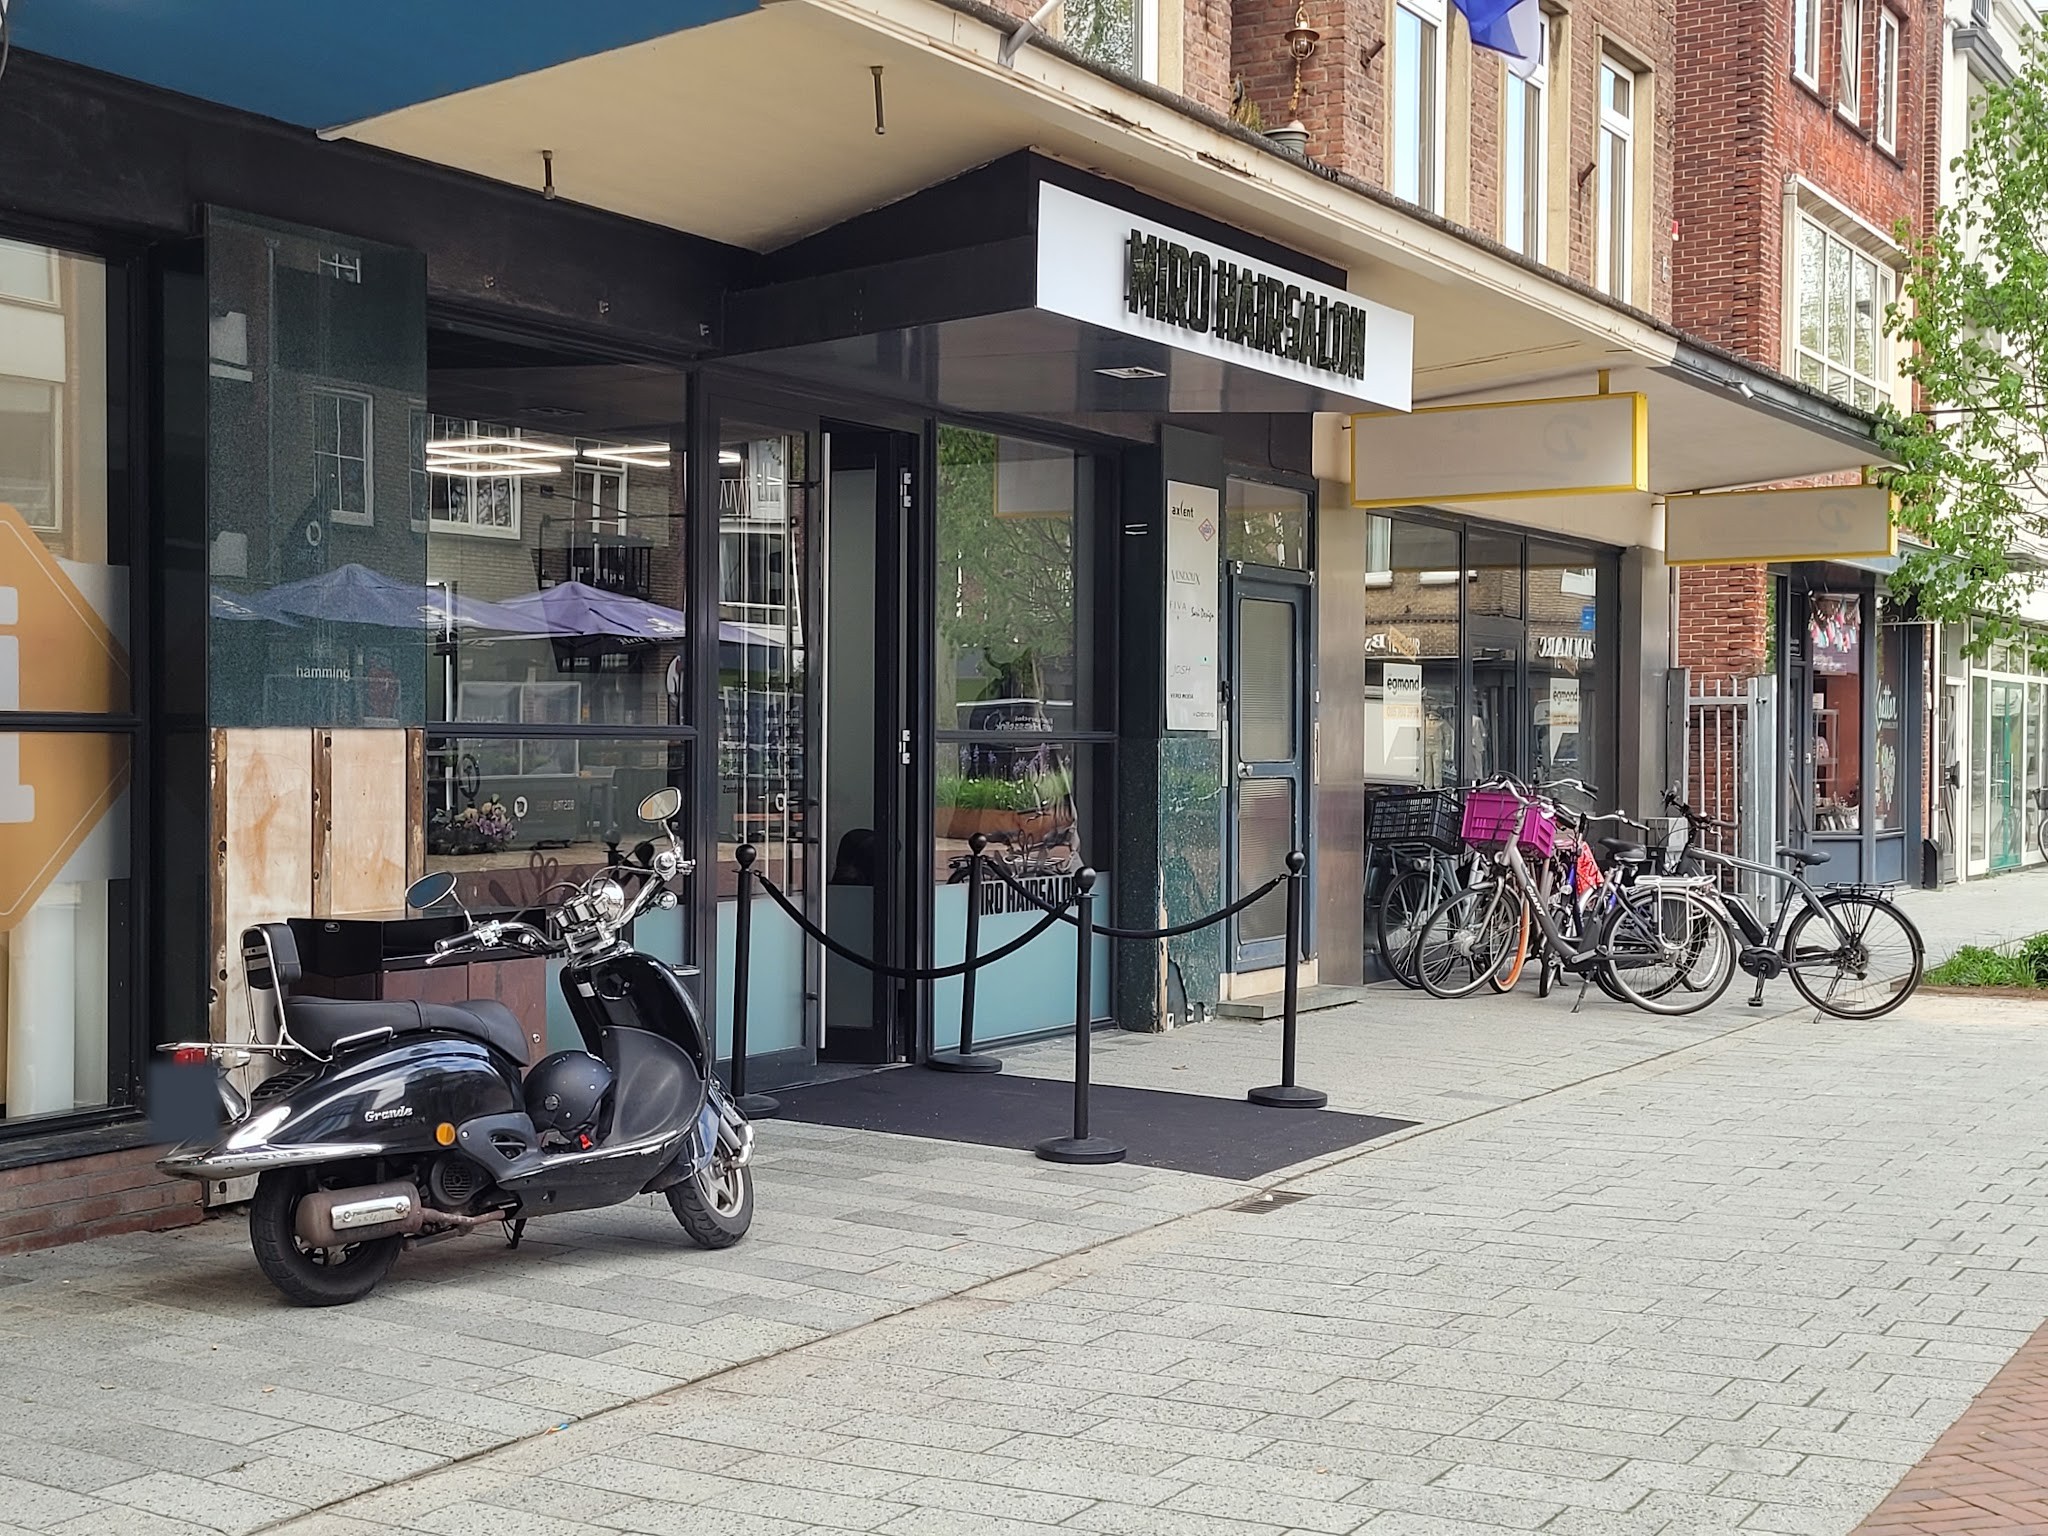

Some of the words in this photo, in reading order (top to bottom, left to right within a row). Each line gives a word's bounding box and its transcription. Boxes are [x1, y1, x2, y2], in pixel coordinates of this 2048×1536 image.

[1127, 228, 1211, 334] MIRO
[1214, 259, 1367, 381] HAIRSALON
[296, 665, 351, 681] hamming
[1387, 674, 1420, 695] egmond
[981, 881, 1005, 917] IRO
[1006, 873, 1079, 914] HAIRSALO
[1526, 885, 1546, 917] GIANT
[364, 1105, 413, 1122] Grande
